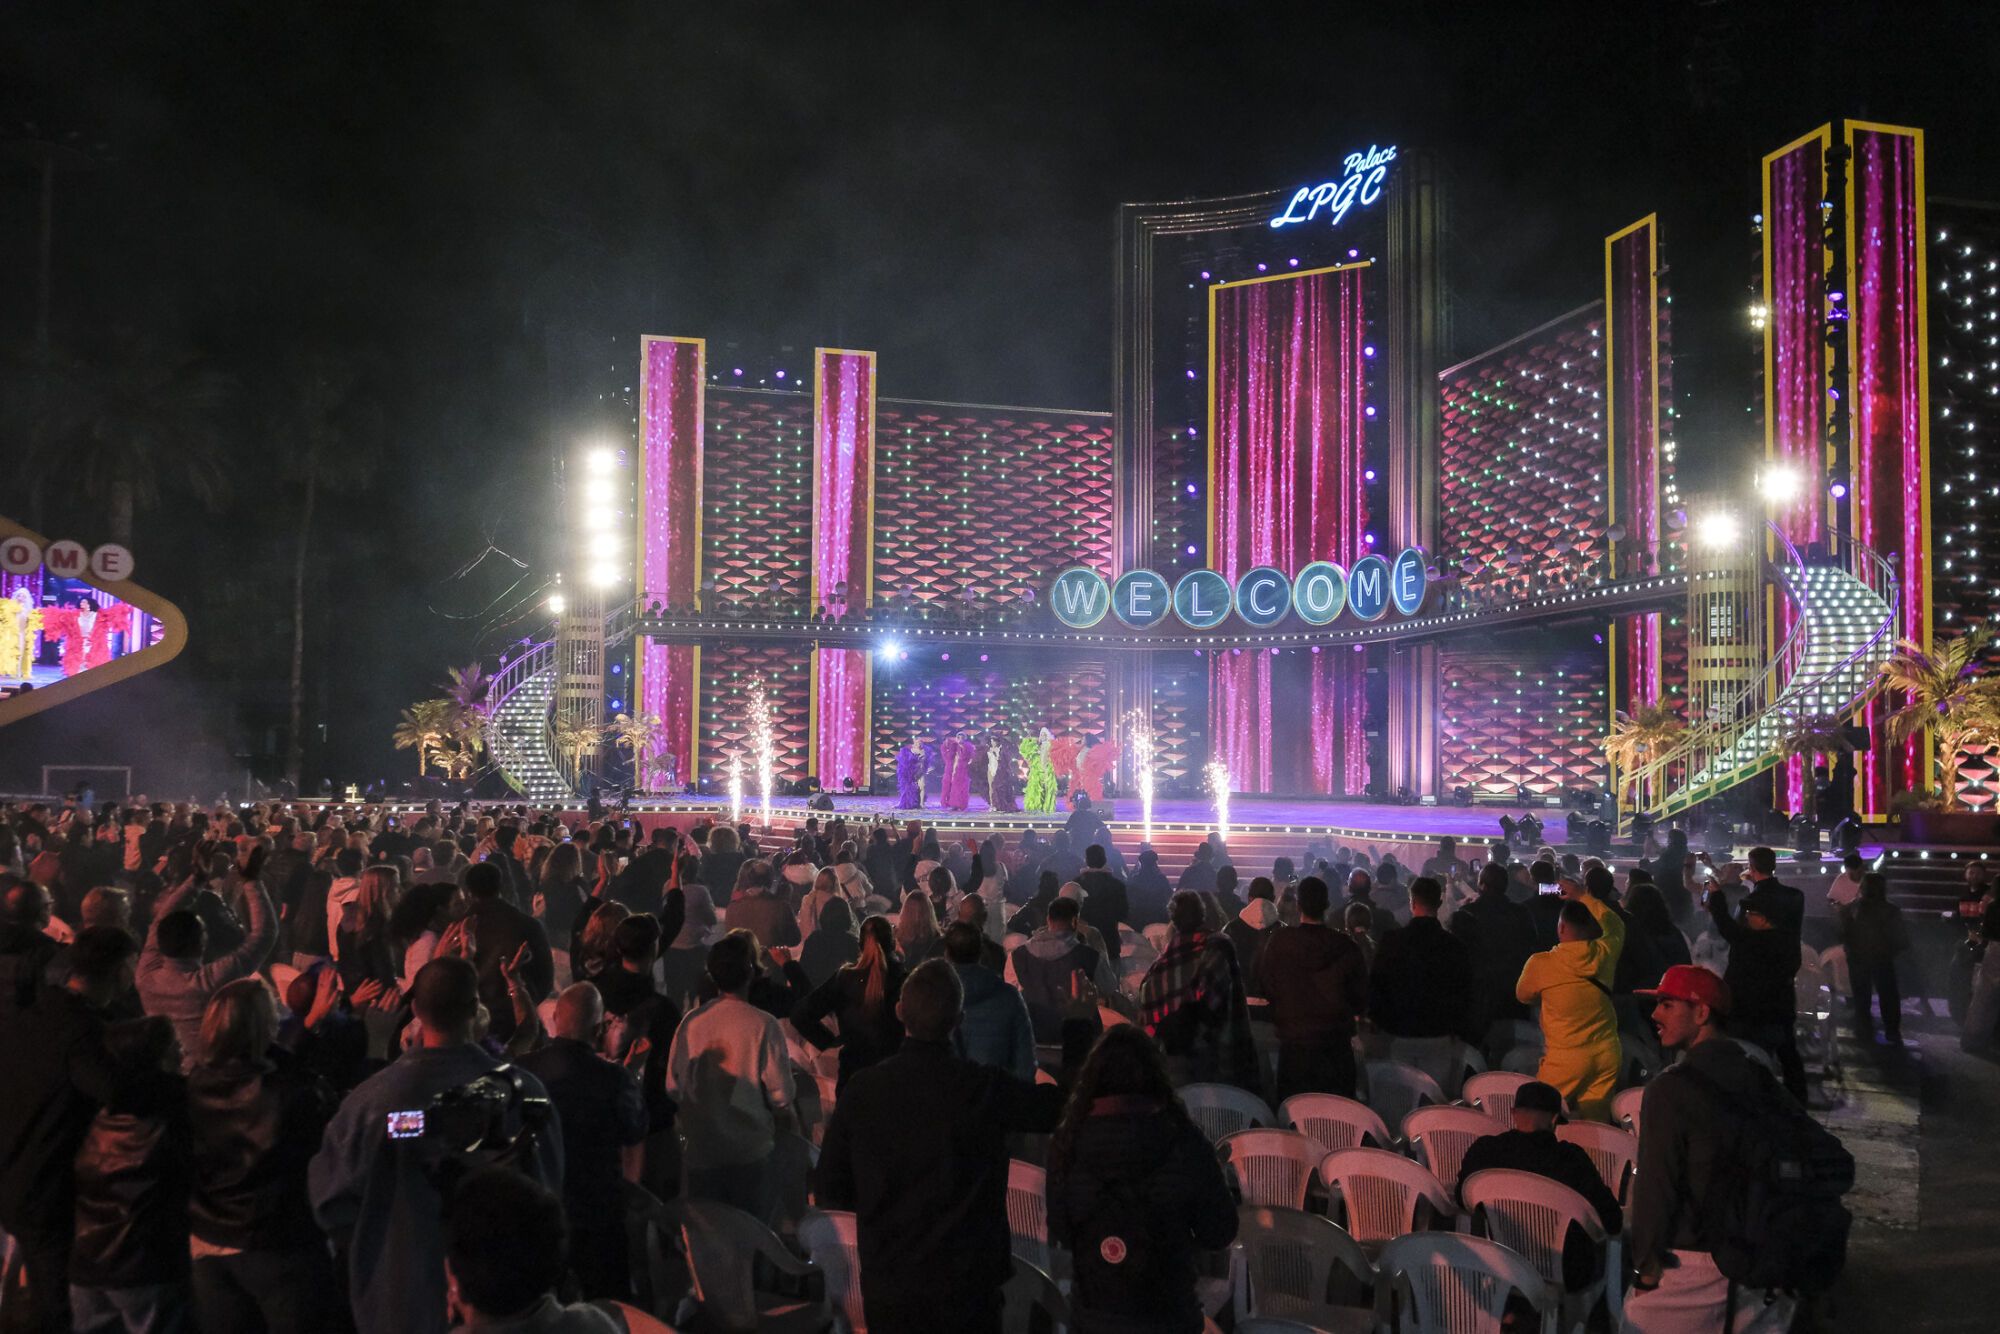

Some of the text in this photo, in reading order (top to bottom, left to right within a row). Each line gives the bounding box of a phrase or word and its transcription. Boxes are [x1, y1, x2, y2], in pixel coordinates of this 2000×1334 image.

[1343, 144, 1397, 177] Palace
[1270, 165, 1387, 228] LPGC
[1061, 560, 1416, 617] WELCOME
